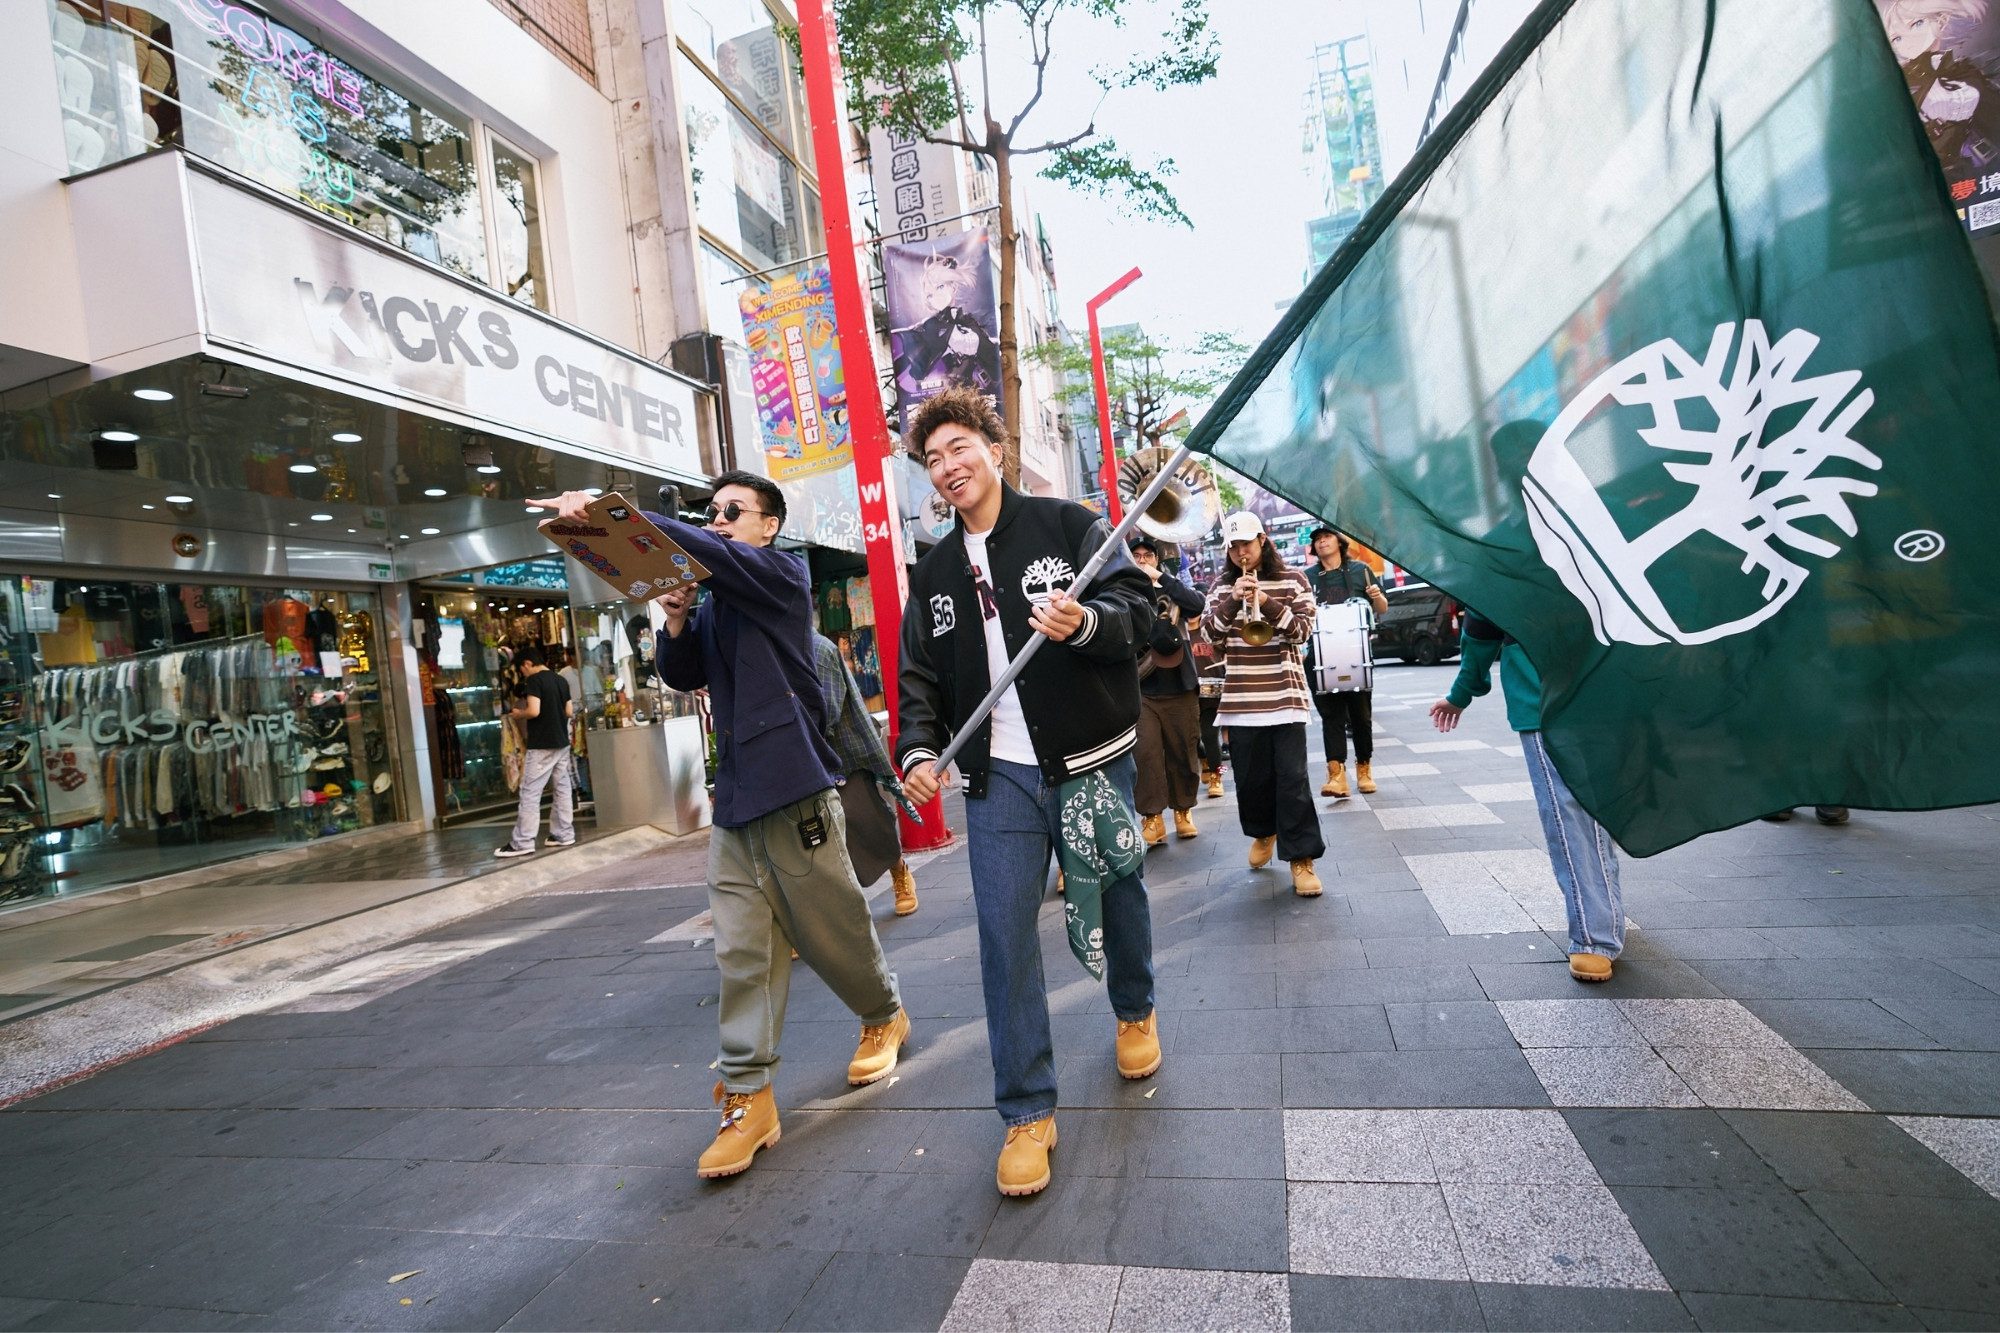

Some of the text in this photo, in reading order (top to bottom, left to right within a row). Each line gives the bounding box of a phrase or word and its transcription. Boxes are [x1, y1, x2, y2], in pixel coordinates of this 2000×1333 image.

[179, 0, 365, 118] COME
[241, 66, 327, 143] AS
[218, 103, 354, 204] YOU
[930, 184, 947, 238] JULIN
[805, 277, 821, 289] TO
[755, 293, 825, 324] XIMENDING
[294, 277, 685, 448] KICKS CENTER
[861, 482, 882, 504] W
[1118, 448, 1216, 504] SOUL HIST
[864, 521, 889, 542] 34
[930, 595, 956, 630] 56
[185, 710, 300, 754] CENTER
